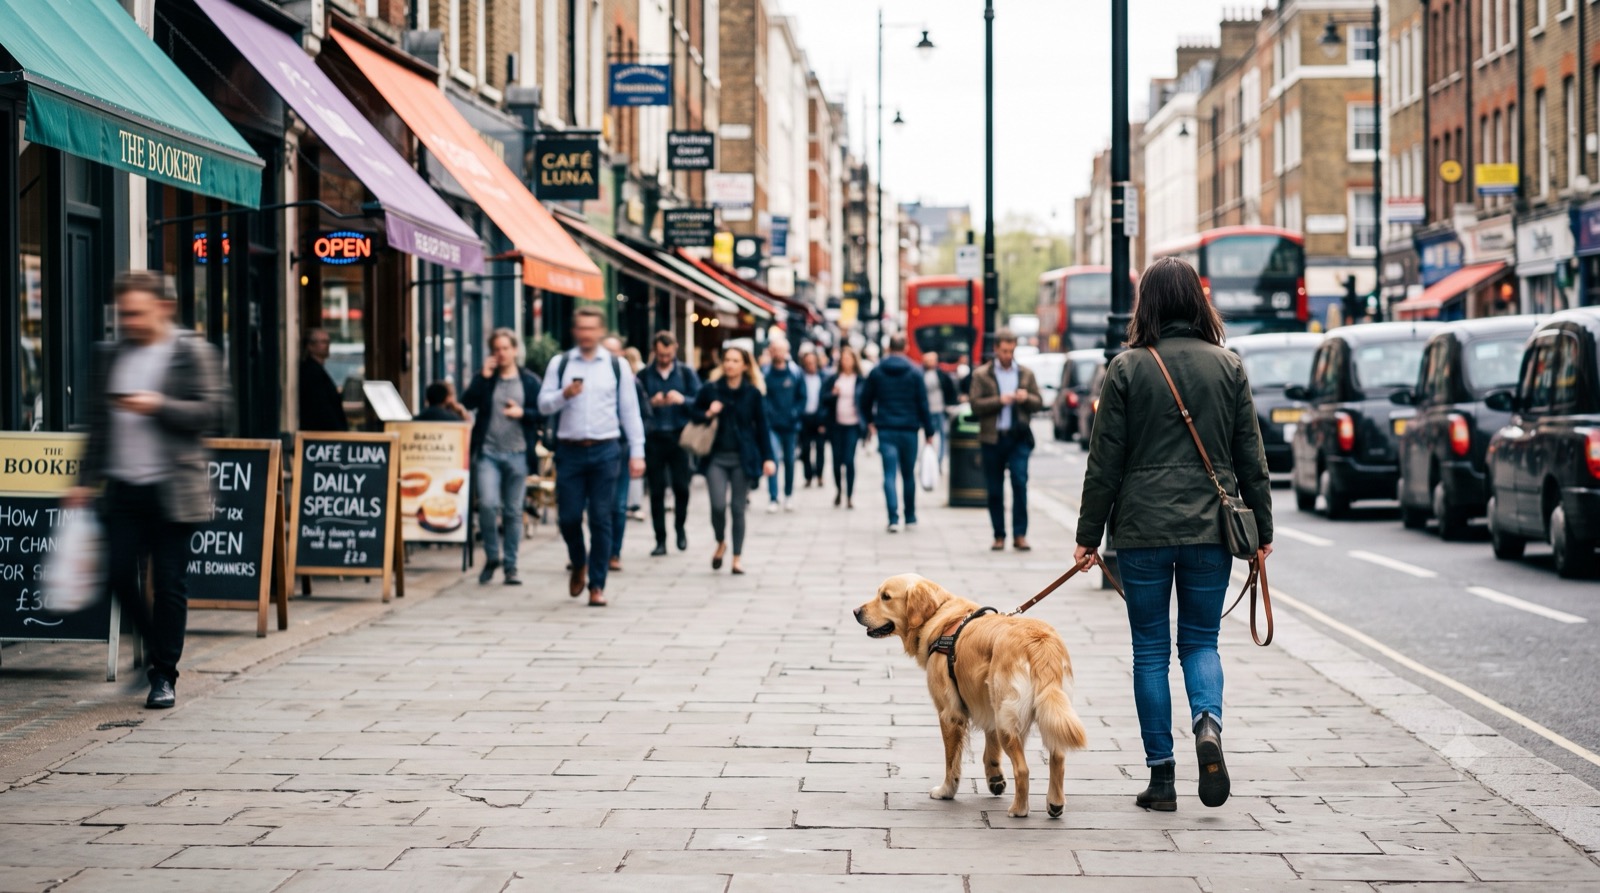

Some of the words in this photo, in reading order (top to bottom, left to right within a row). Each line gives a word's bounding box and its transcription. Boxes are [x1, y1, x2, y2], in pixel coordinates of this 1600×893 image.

[119, 129, 146, 168] THE
[147, 139, 203, 186] BOOKERY
[541, 150, 593, 170] CAFÉ
[541, 170, 594, 187] LUNA
[314, 237, 371, 258] OPEN
[413, 432, 443, 441] DAILY
[43, 447, 64, 456] THE
[347, 445, 387, 464] LUNA
[4, 457, 80, 476] BOOKE
[206, 461, 252, 492] PEN
[313, 472, 367, 494] DAILY
[303, 495, 382, 518] SPECIALS
[190, 531, 243, 555] OPEN
